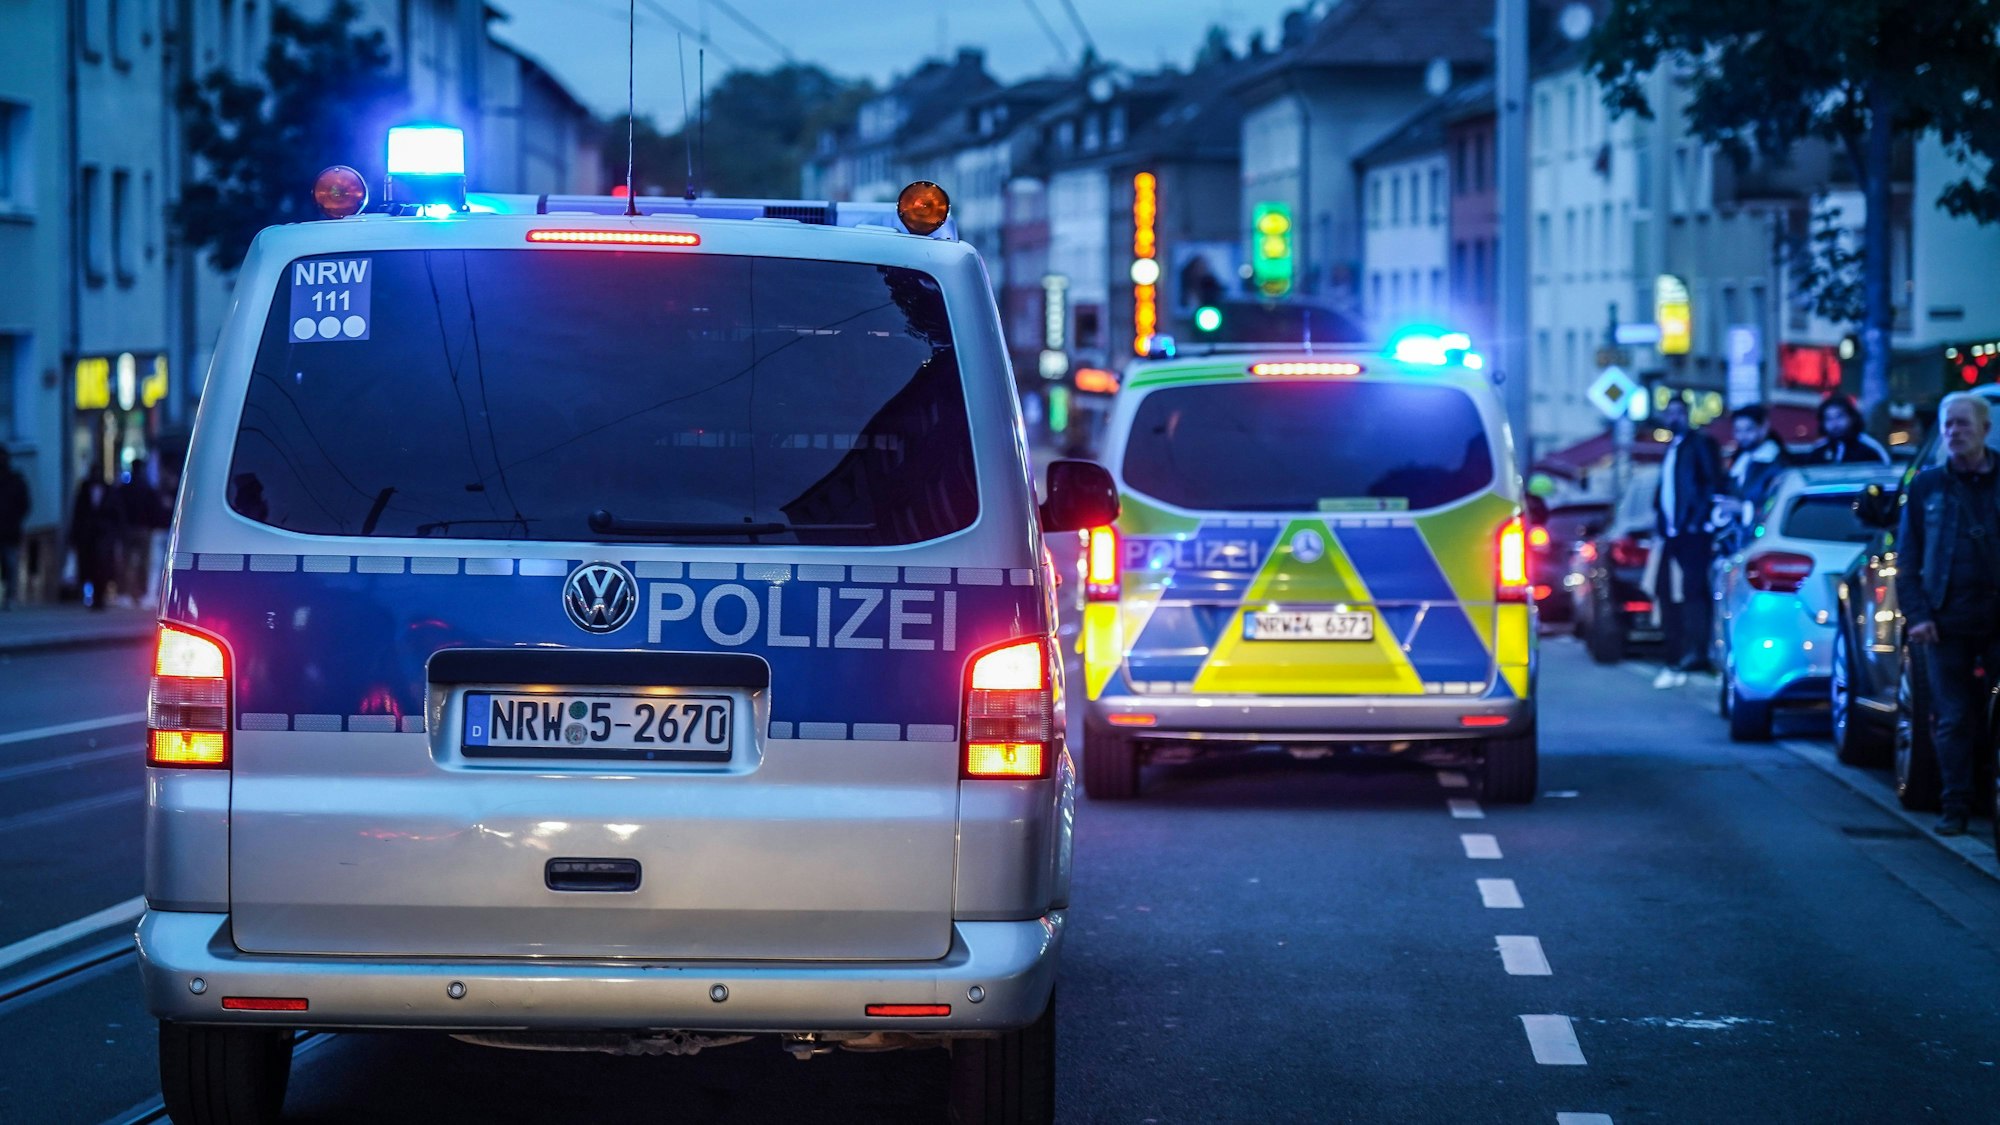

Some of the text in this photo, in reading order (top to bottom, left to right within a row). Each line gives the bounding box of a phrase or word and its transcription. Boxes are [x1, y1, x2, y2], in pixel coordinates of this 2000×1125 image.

[295, 260, 368, 286] NRW
[311, 290, 350, 312] 111
[1124, 540, 1258, 570] POLIZEI
[565, 563, 634, 631] VW
[648, 582, 957, 651] POLIZEI
[472, 725, 482, 737] D
[491, 699, 727, 745] NRW 5-2670
